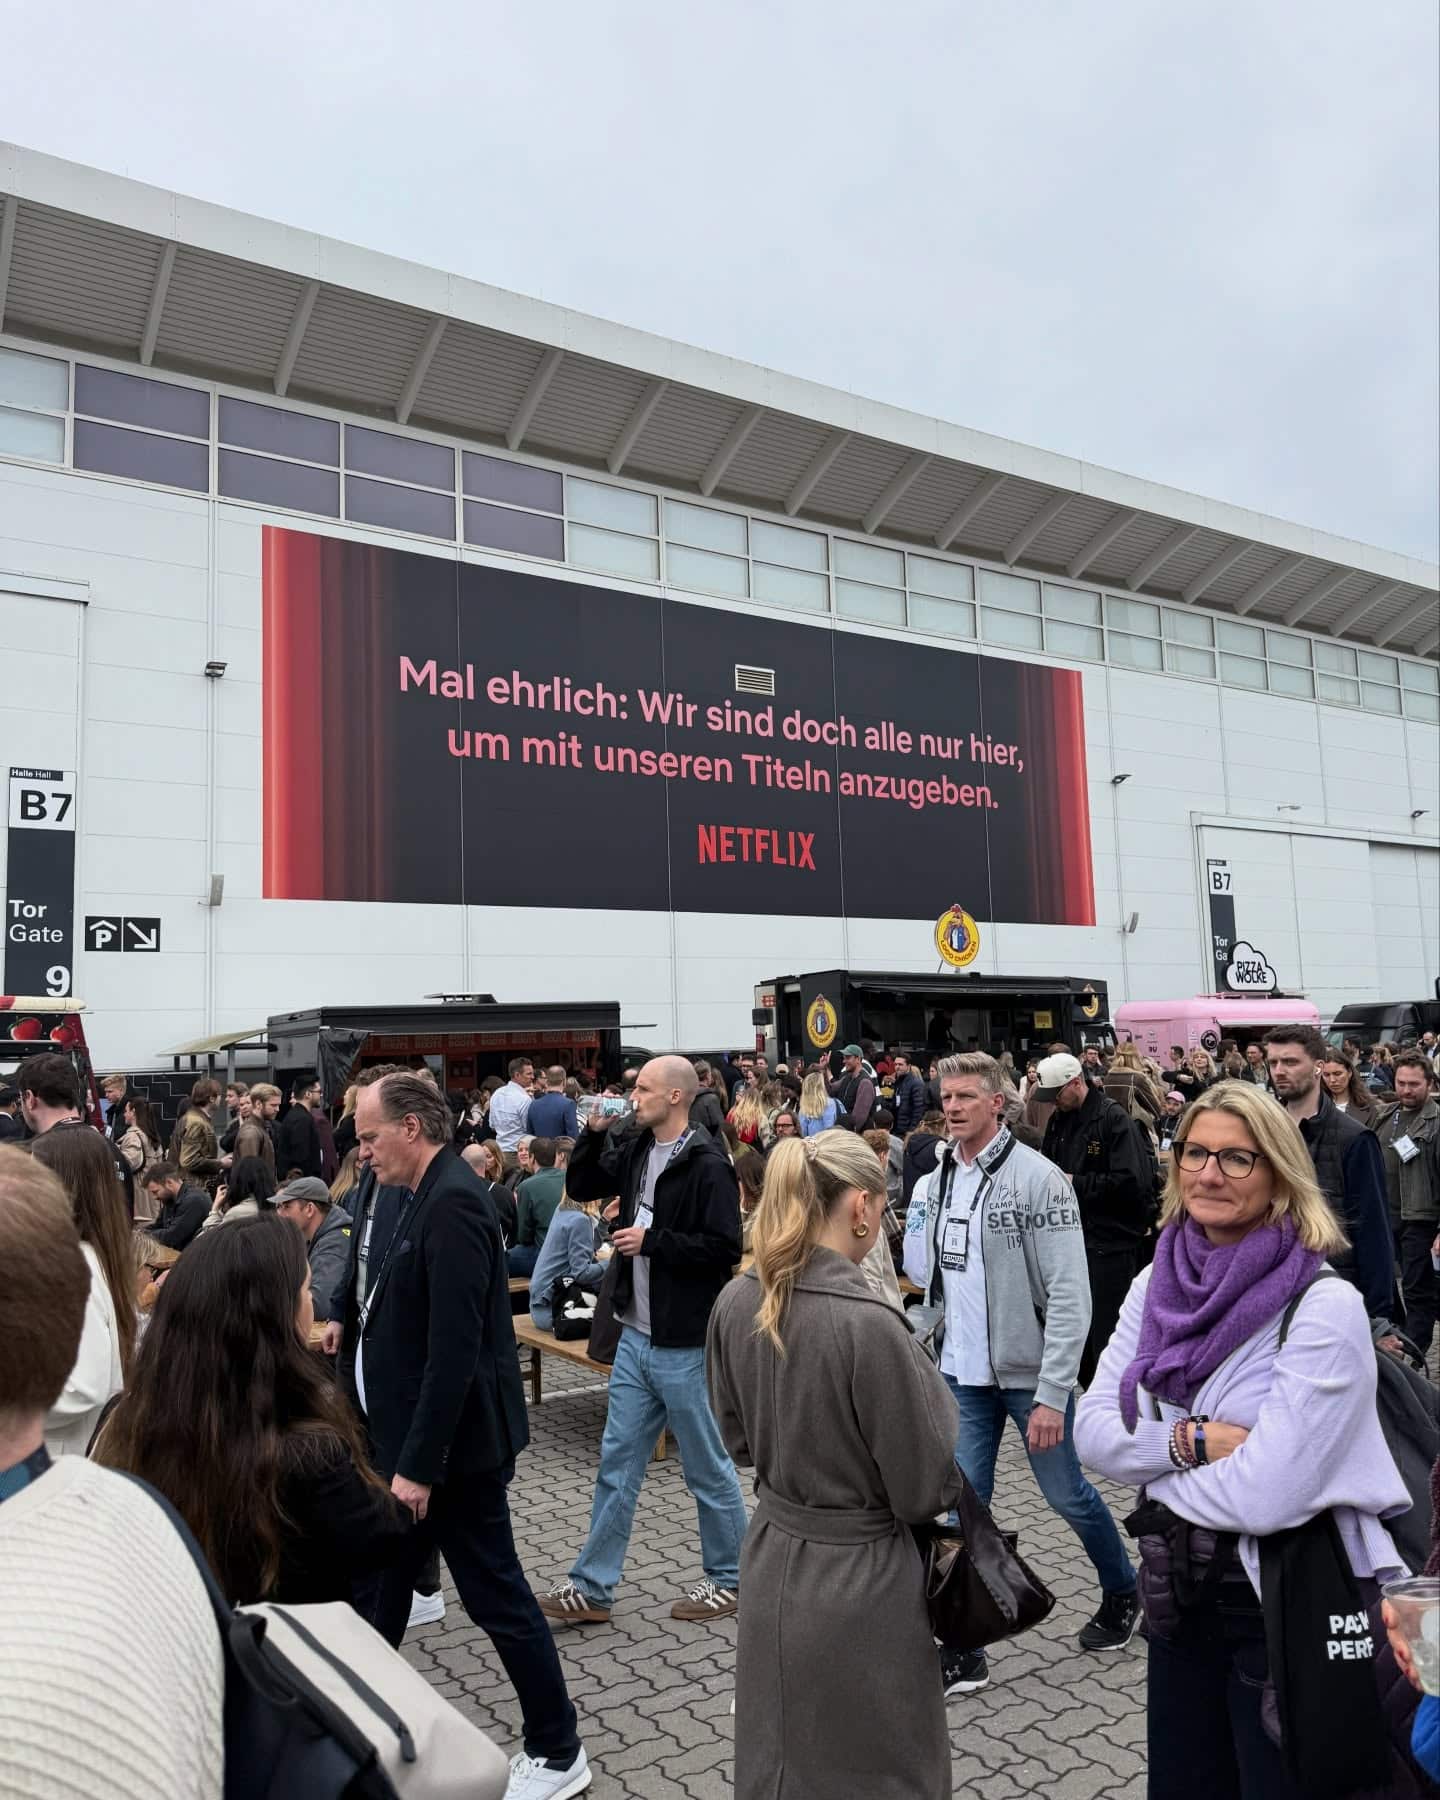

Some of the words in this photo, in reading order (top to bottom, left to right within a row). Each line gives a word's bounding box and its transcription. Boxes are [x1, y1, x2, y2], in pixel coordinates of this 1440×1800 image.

[400, 655, 474, 700] Mal
[487, 670, 628, 720] ehrlich:
[638, 689, 698, 728] Wir
[706, 699, 773, 737] sind
[782, 709, 857, 748] doch
[864, 721, 912, 754] alle
[920, 733, 963, 760] nur
[970, 733, 1024, 773] hier,
[12, 769, 33, 777] Halle
[448, 729, 509, 761] um
[522, 731, 582, 768] mit
[594, 745, 733, 783] unseren
[741, 753, 830, 793] Titeln
[839, 771, 999, 810] anzugeben.
[21, 790, 72, 822] B7
[698, 824, 816, 871] NETFLIX
[1213, 872, 1231, 891] B7
[9, 900, 47, 918] Tor
[9, 924, 63, 943] Gate
[1214, 936, 1228, 947] Tor
[1215, 950, 1228, 961] Ga
[1237, 961, 1262, 972] PIZZA
[46, 965, 70, 997] 9
